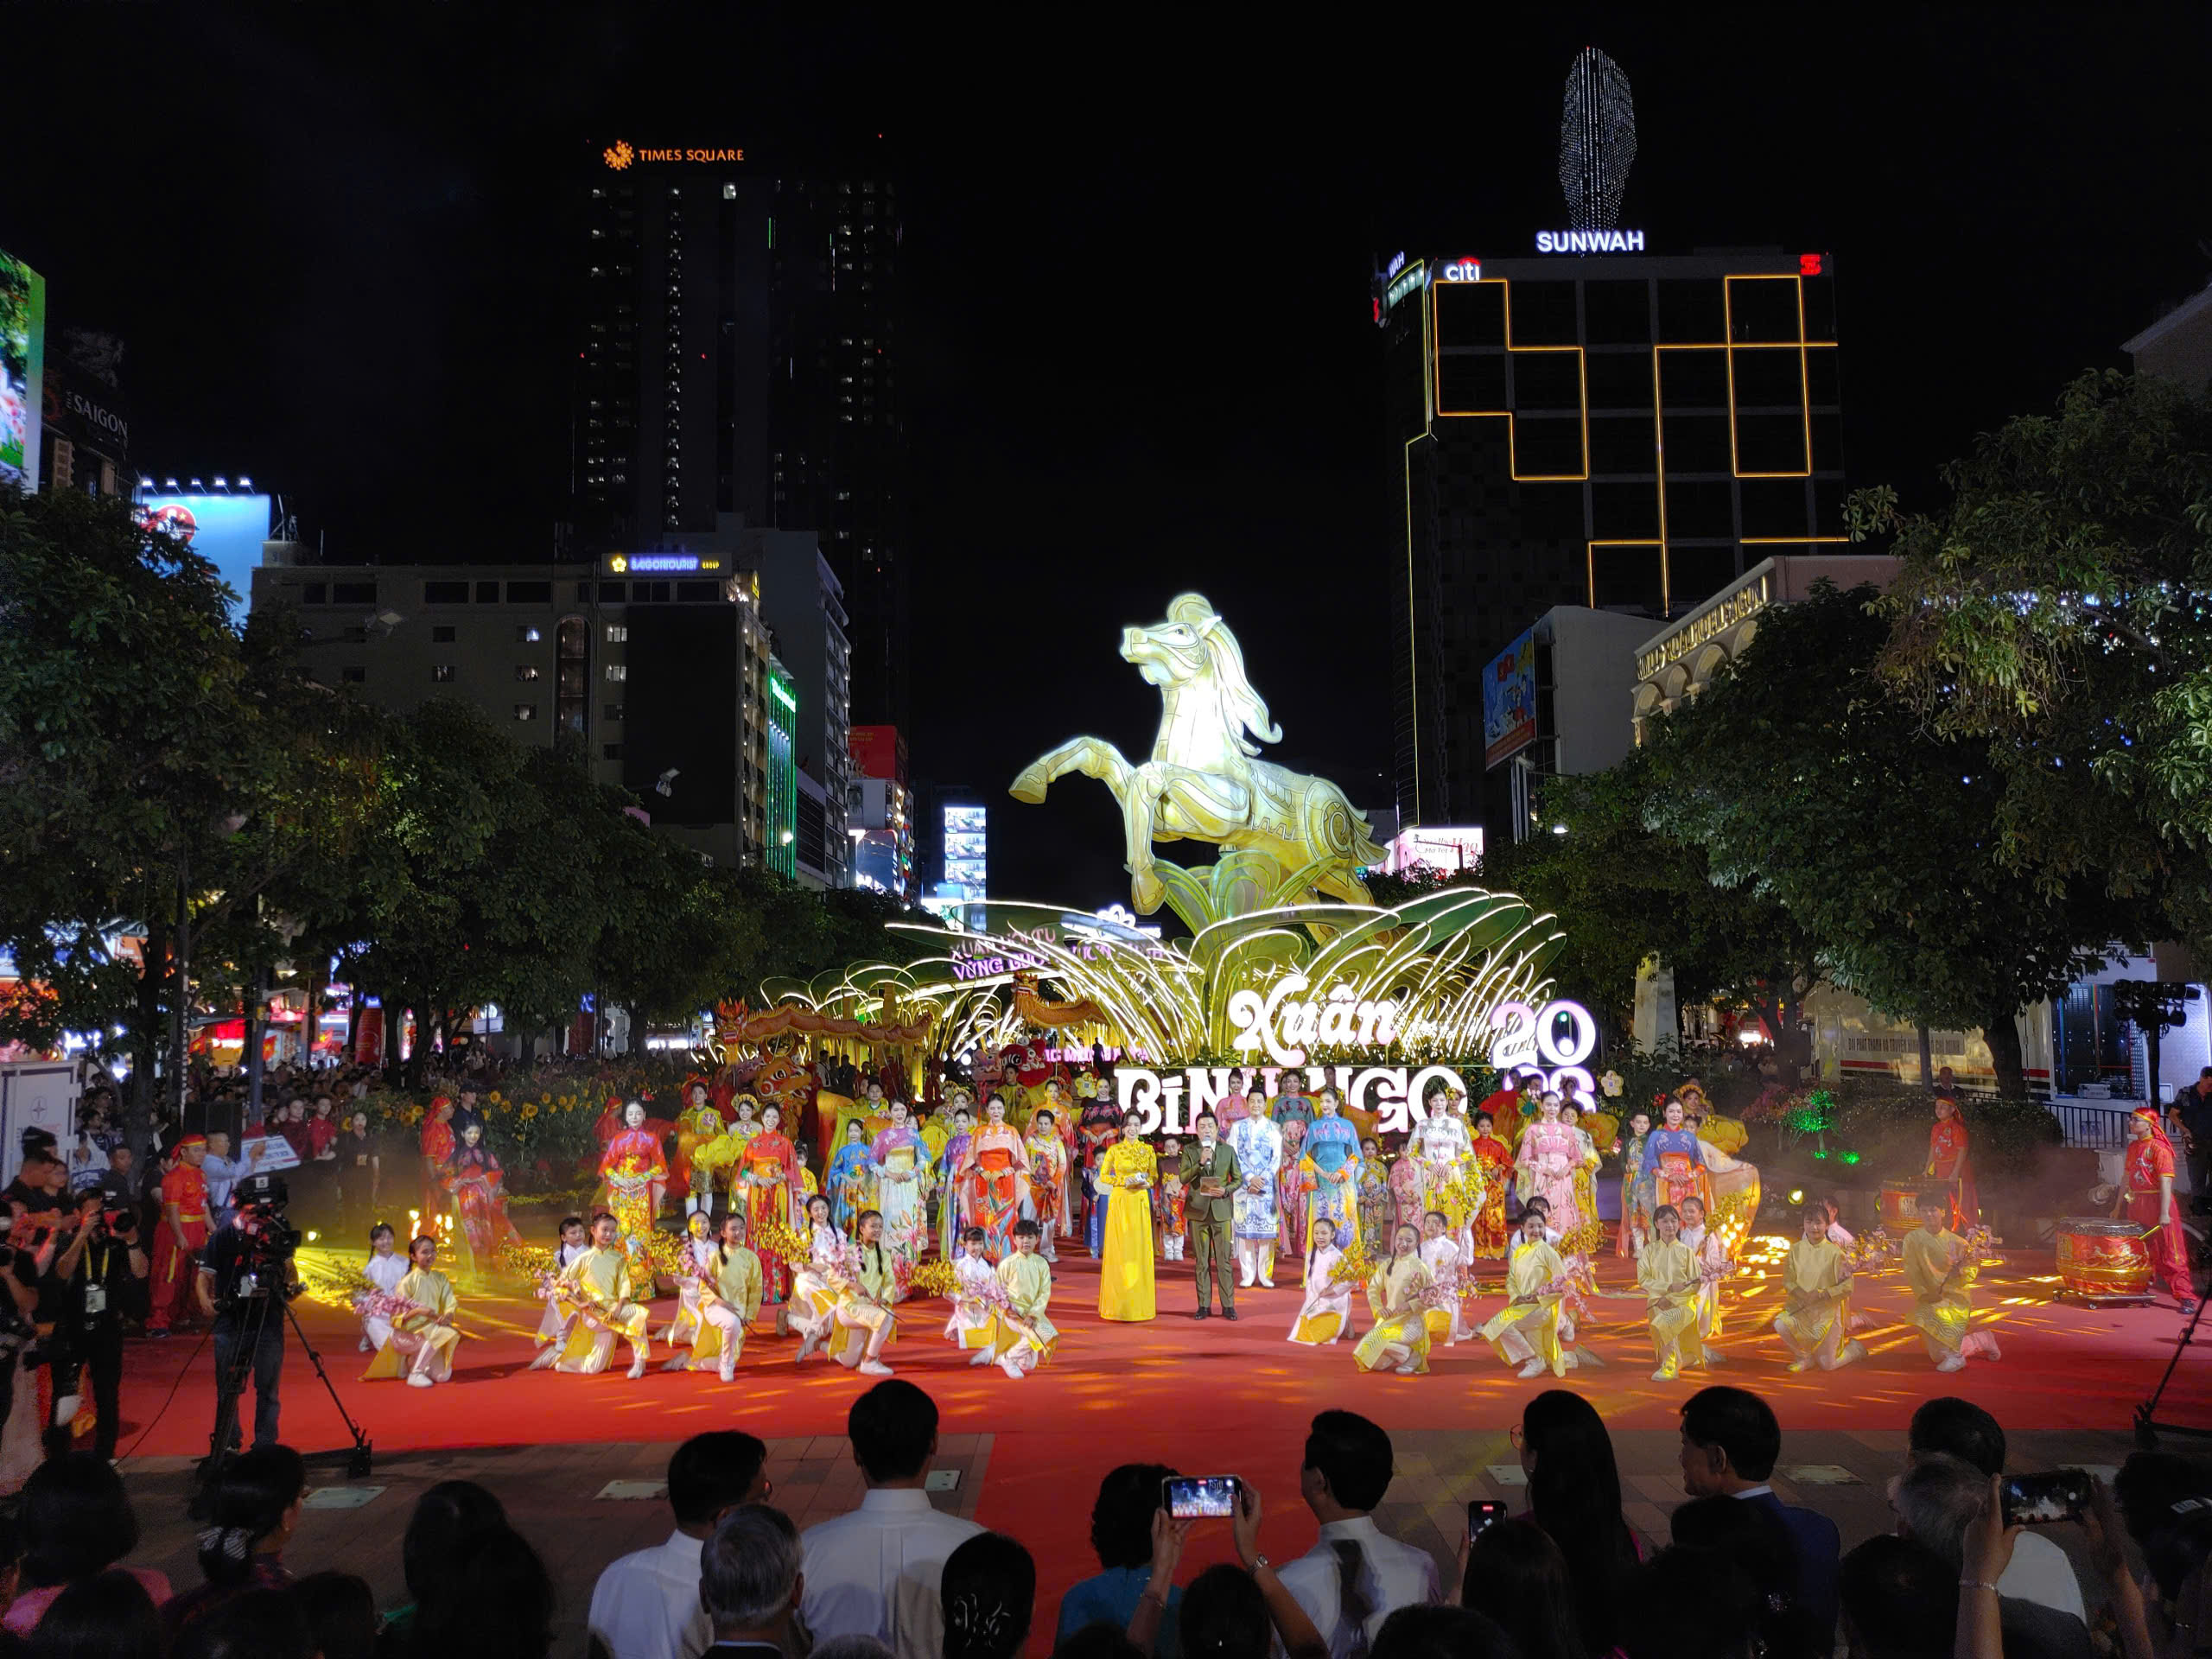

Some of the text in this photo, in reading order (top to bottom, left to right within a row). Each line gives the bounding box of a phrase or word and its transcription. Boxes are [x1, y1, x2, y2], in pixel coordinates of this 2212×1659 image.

[639, 149, 745, 163] TIMES SQUARE
[1536, 230, 1644, 252] SUNWAH
[1446, 262, 1480, 281] citi
[73, 394, 128, 439] SAIGON
[631, 556, 720, 571] SAIGONTOURIST GROUP
[1229, 975, 1399, 1067] Xuân
[1491, 1001, 1596, 1069] 20
